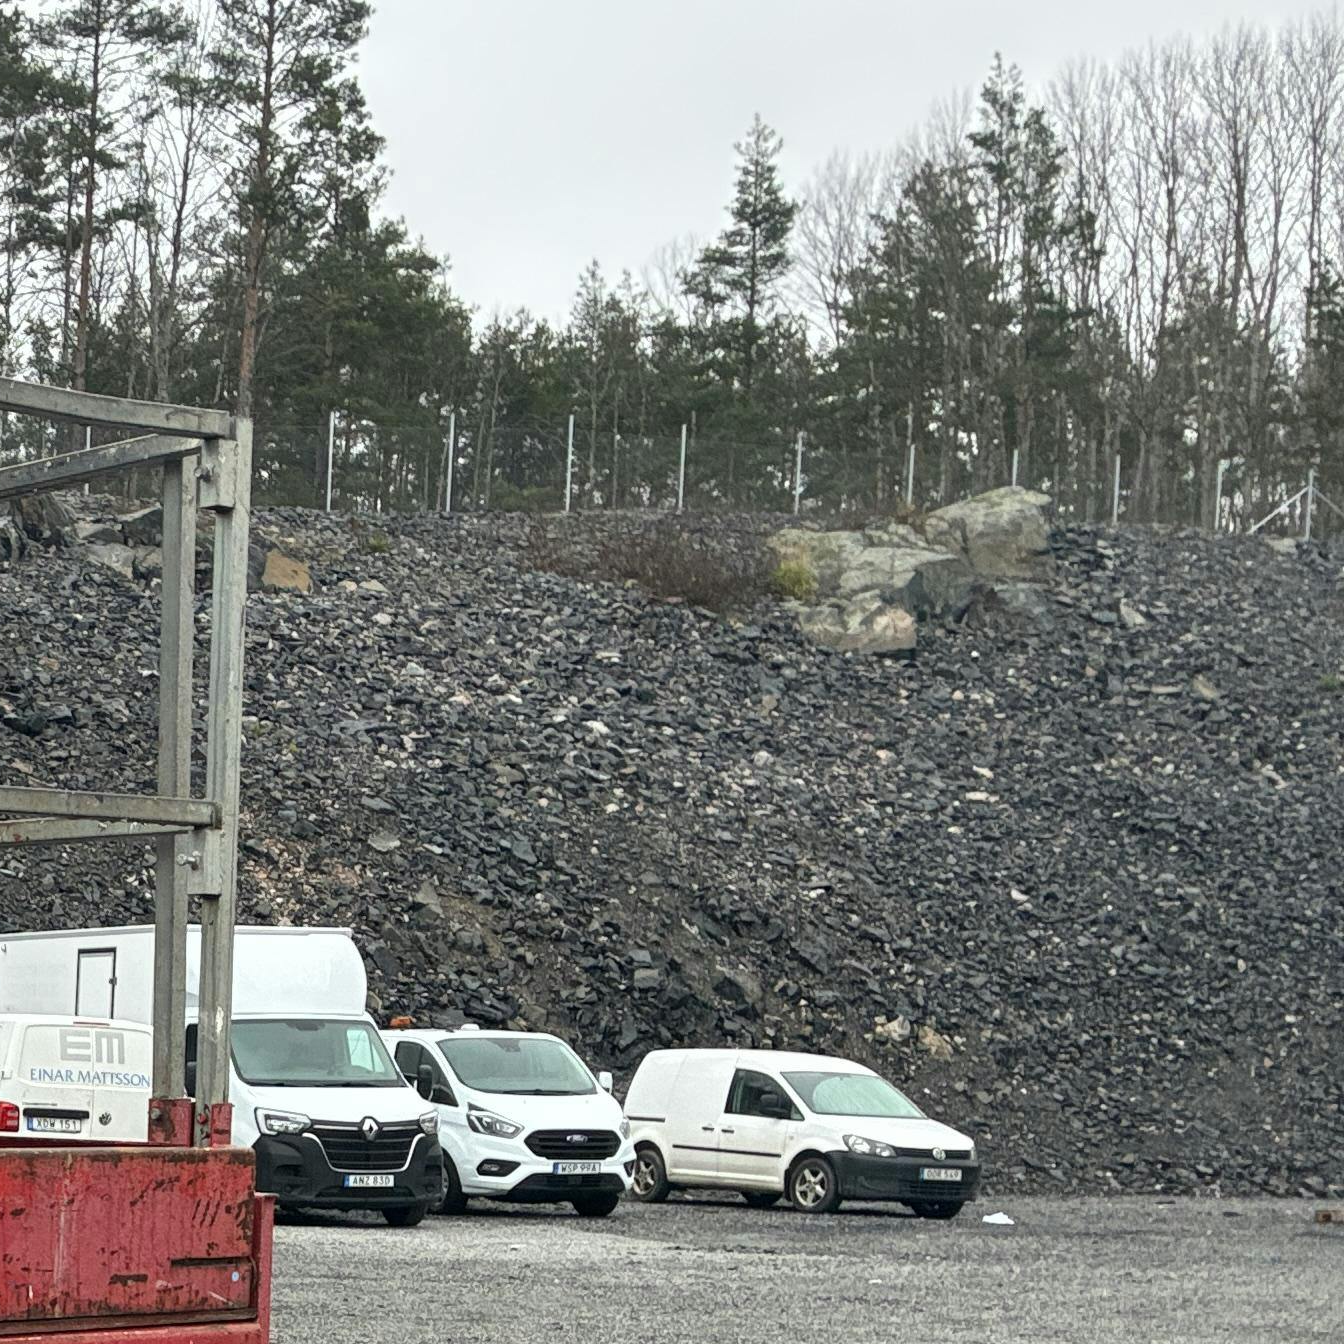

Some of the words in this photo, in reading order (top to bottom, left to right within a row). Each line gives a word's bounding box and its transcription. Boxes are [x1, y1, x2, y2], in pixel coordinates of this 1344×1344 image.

[30, 1068, 75, 1083] EINAR
[77, 1070, 150, 1088] MATTSSON
[60, 1119, 77, 1130] 151
[352, 1176, 370, 1185] ANZ
